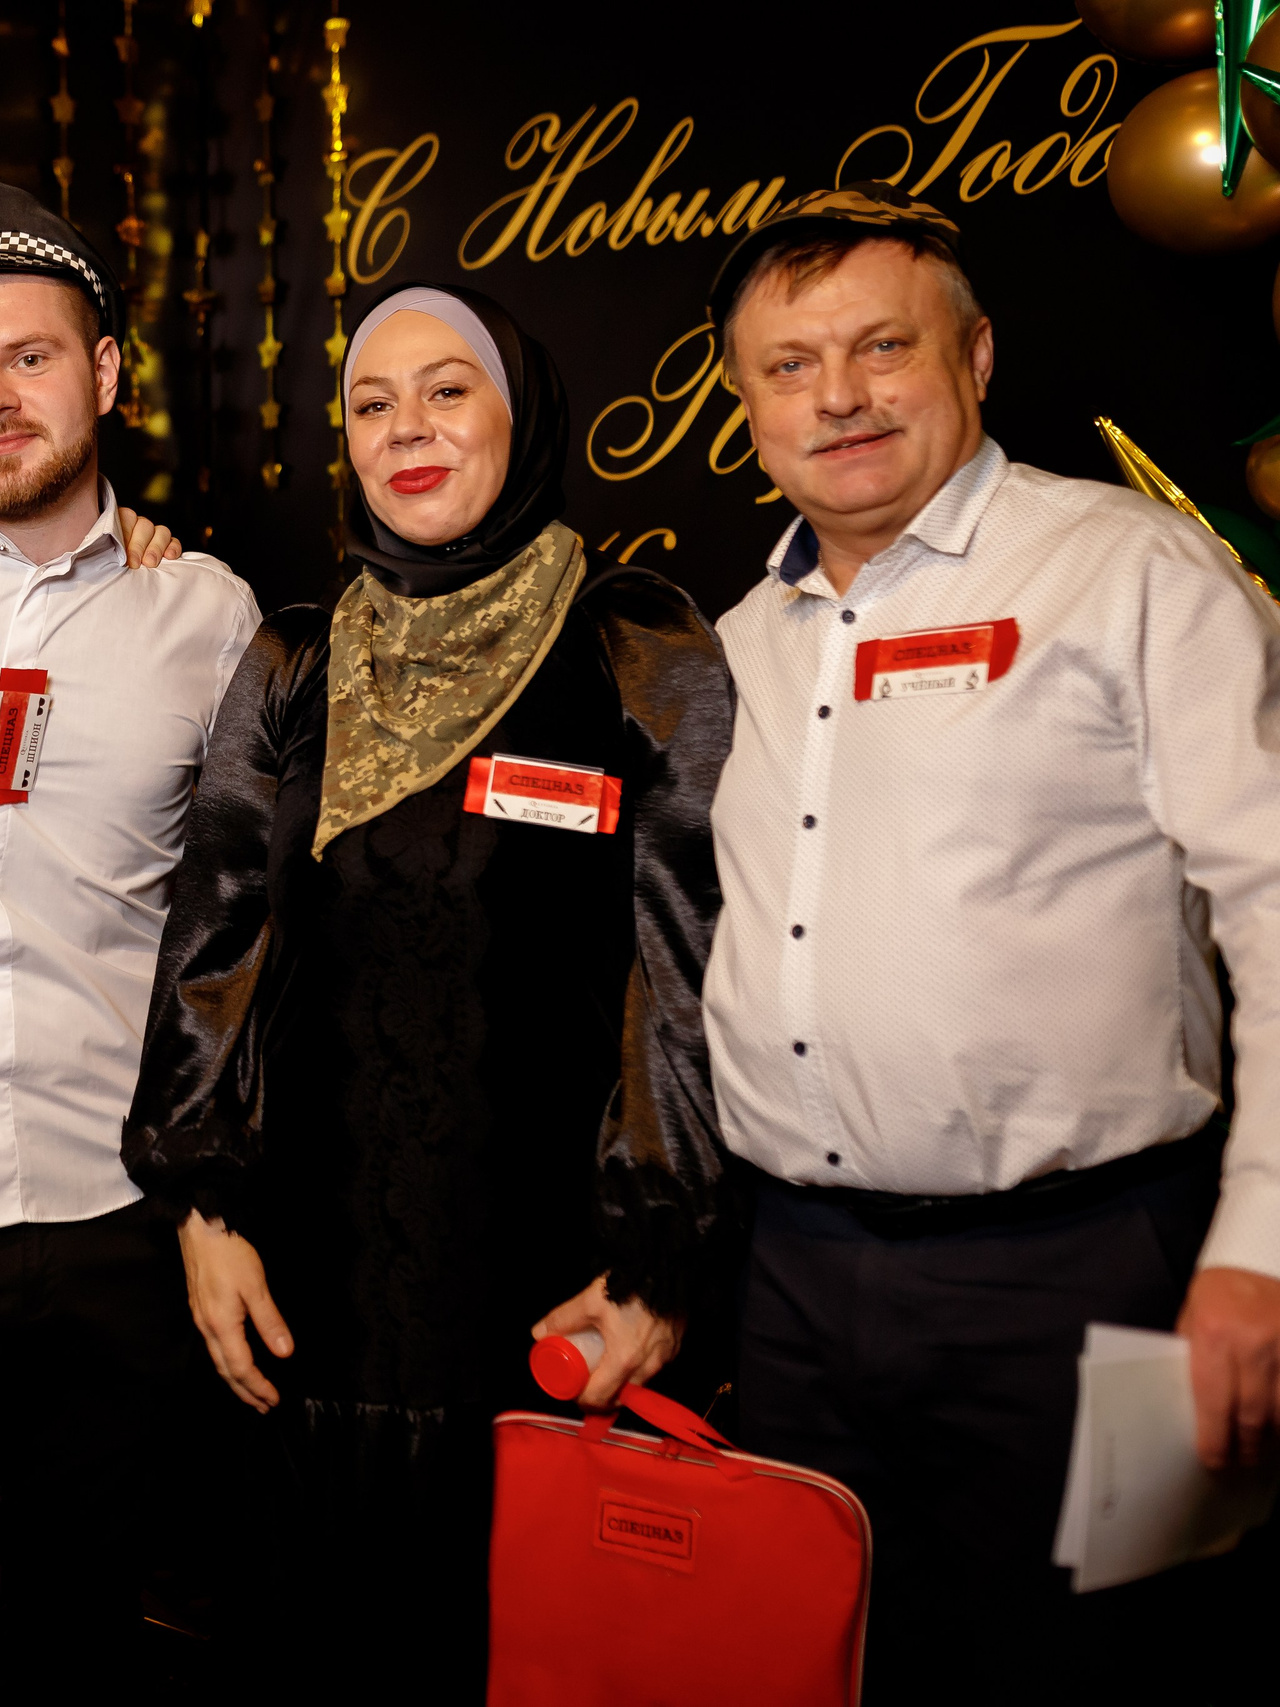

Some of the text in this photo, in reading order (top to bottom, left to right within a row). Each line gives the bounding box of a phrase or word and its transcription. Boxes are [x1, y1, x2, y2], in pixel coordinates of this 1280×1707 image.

[343, 17, 1122, 285] С Новым Годо
[893, 642, 972, 662] СПЕЦНАЗ
[26, 722, 42, 763] ШПИОН
[509, 774, 585, 796] СПЕЦНАЗ
[520, 808, 566, 823] ДОКТОР
[607, 1517, 684, 1545] СПЕЦНАЗ
